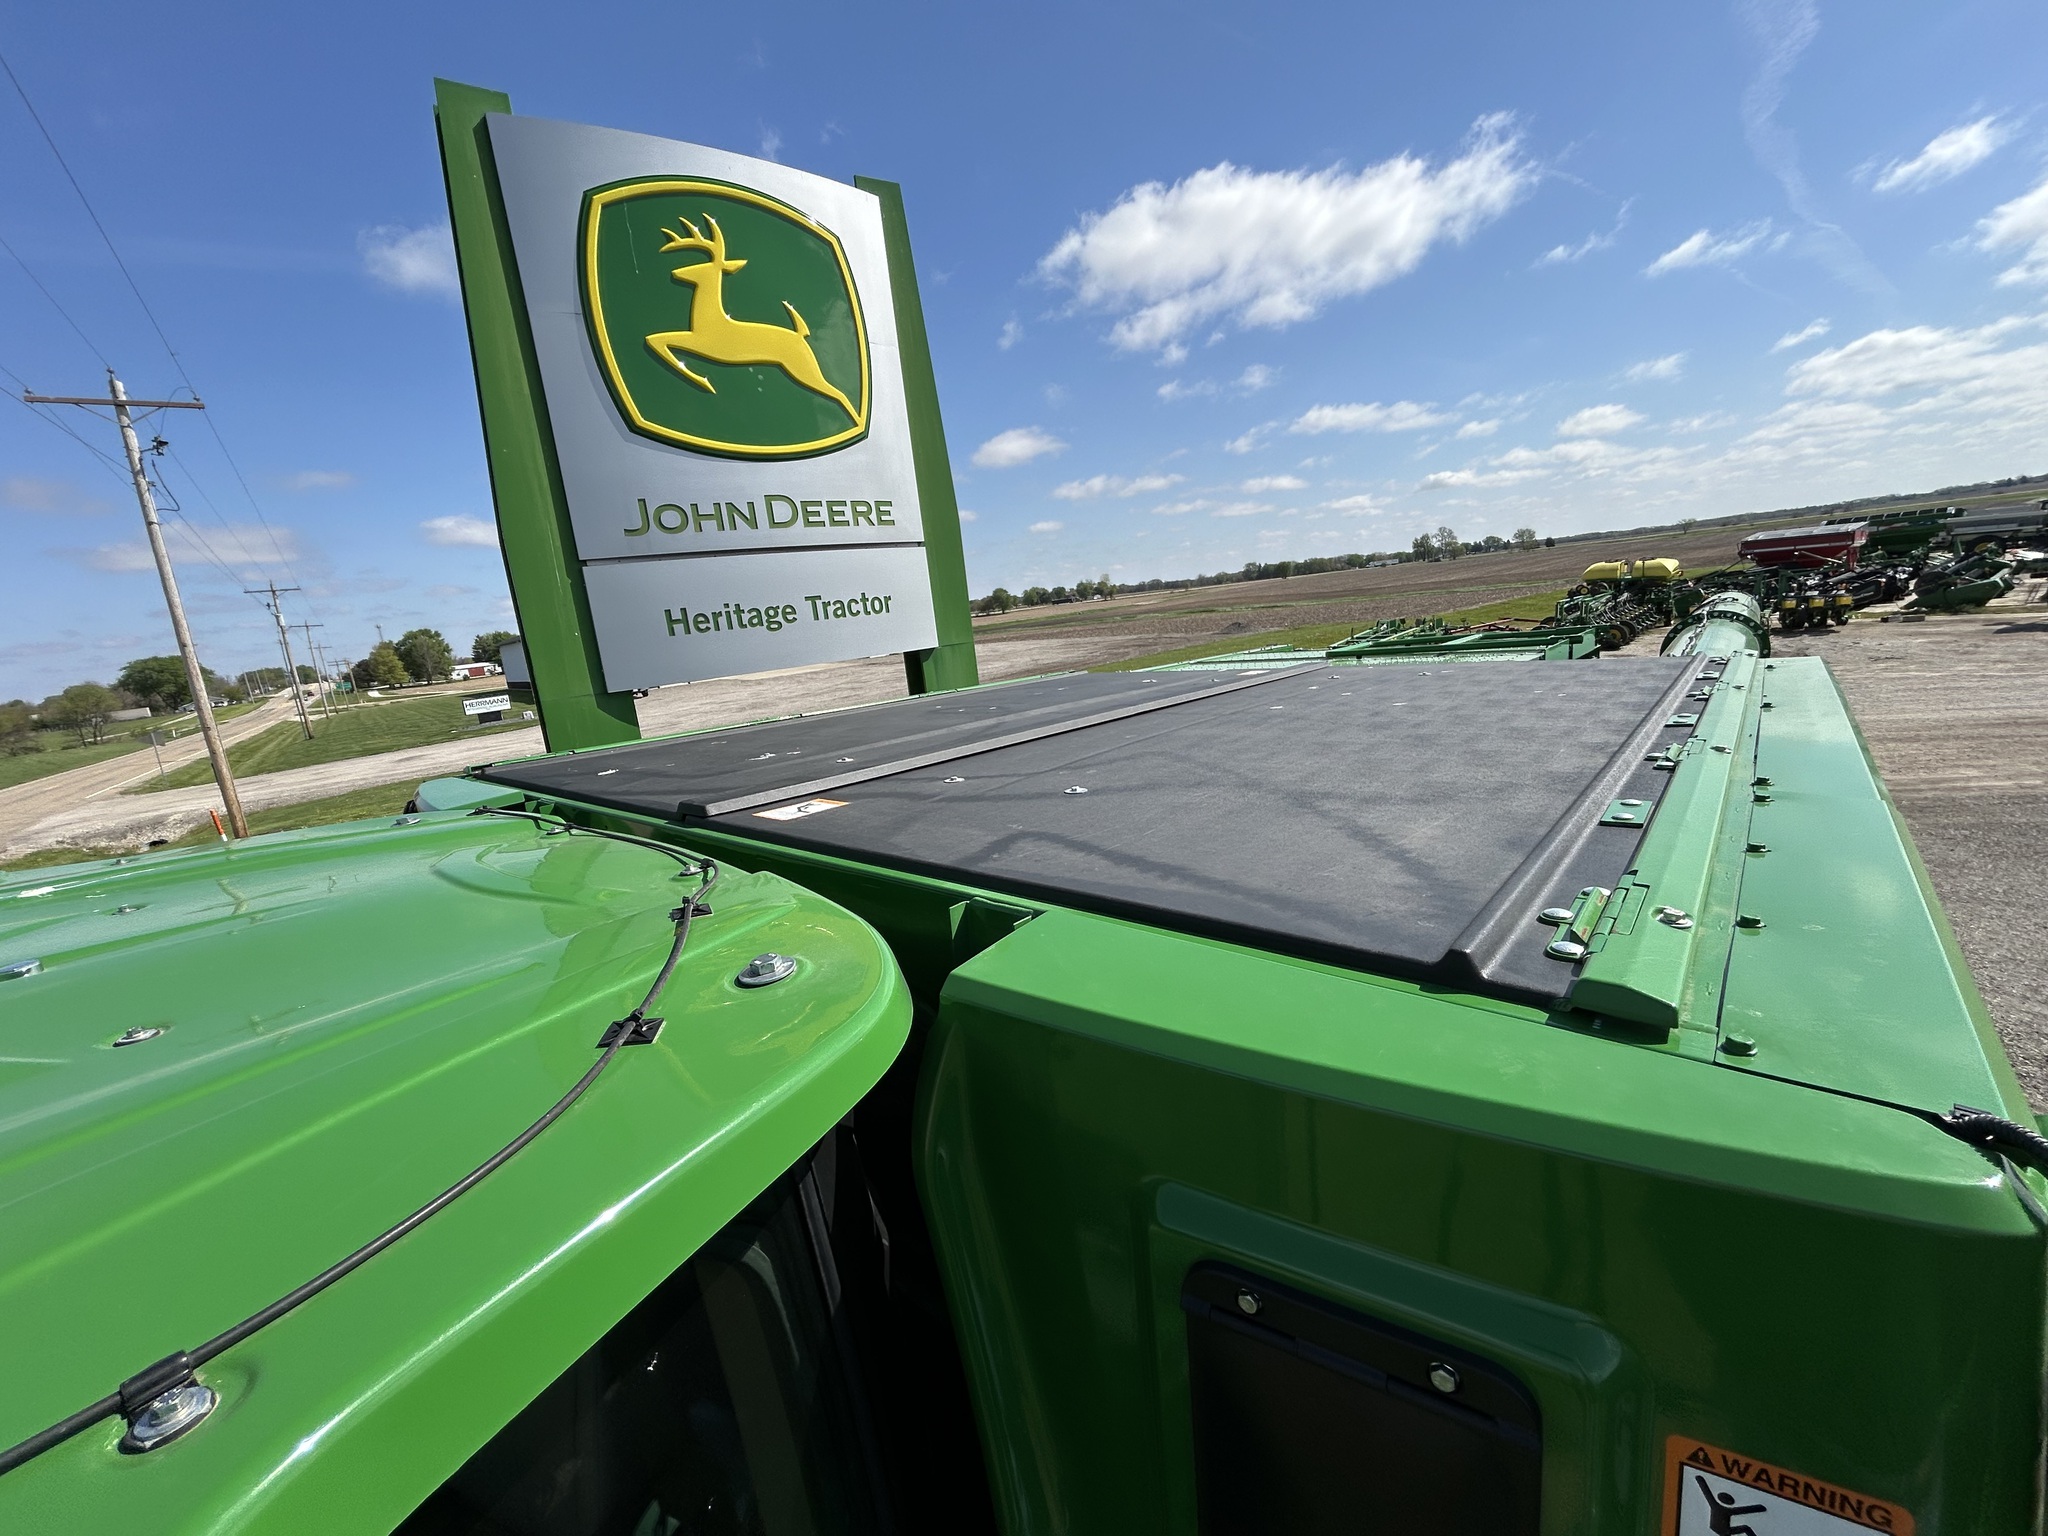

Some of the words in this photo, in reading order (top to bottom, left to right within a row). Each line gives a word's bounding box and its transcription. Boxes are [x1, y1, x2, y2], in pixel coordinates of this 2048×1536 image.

[623, 498, 759, 537] JOHN
[764, 494, 896, 529] DEERE
[663, 602, 798, 637] Heritage
[804, 591, 892, 622] Tractor
[465, 697, 509, 708] HERRMANN
[1721, 1454, 1894, 1529] WARNING
